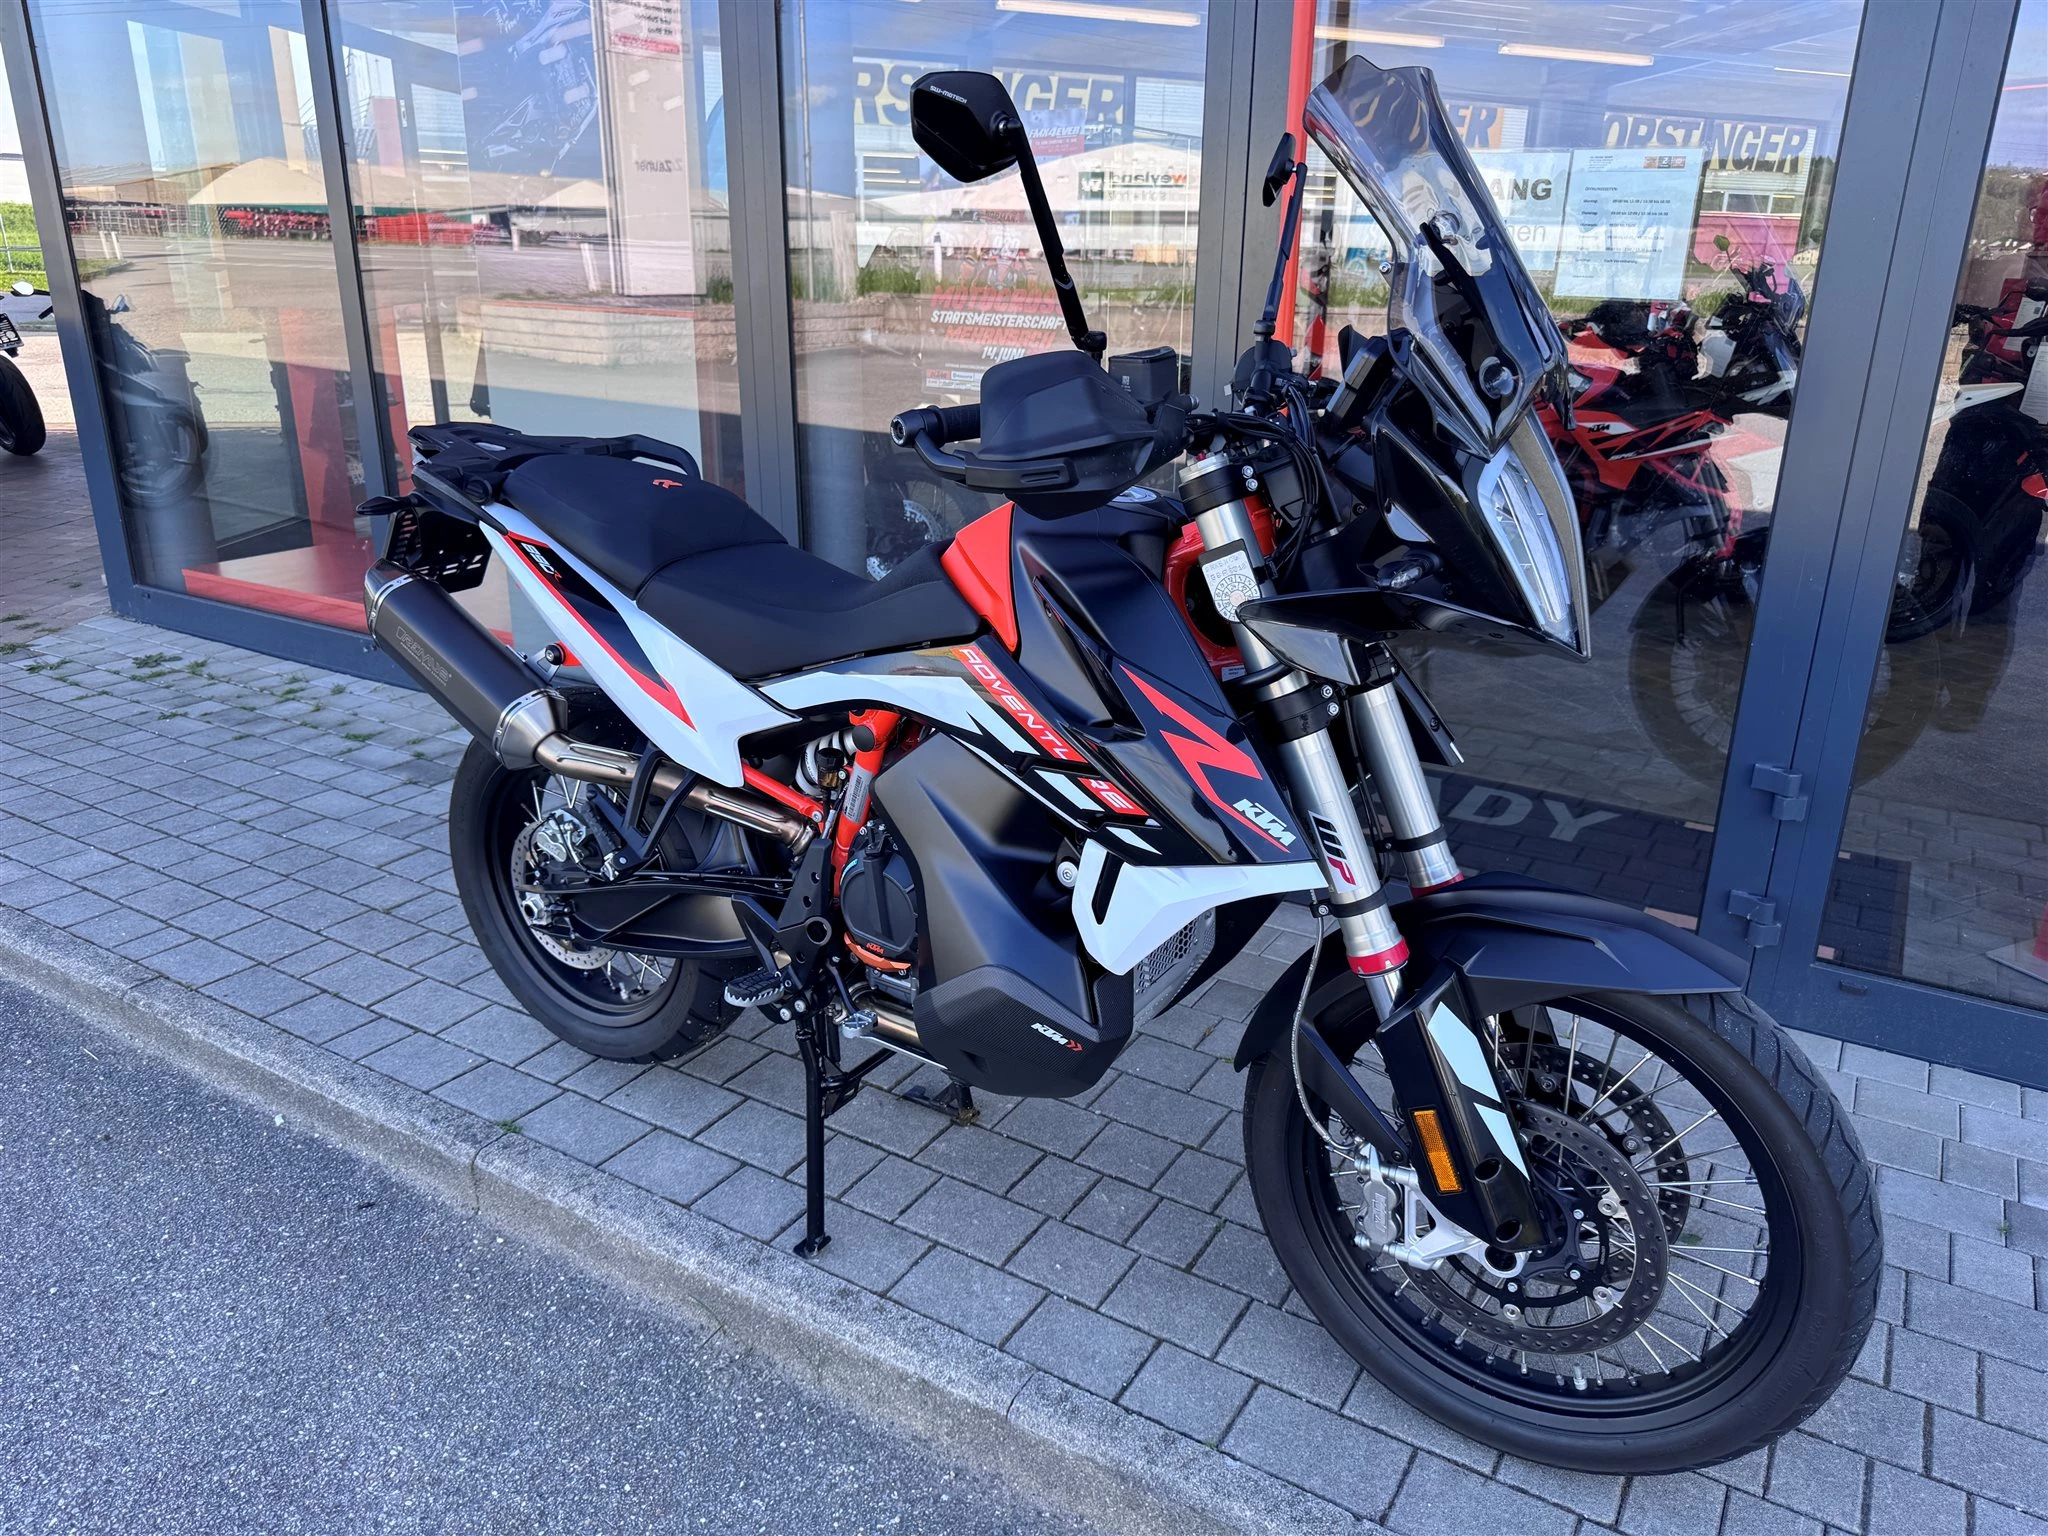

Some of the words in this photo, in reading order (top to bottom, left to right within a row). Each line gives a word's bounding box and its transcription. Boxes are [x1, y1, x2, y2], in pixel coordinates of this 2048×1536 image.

[1604, 114, 1808, 173] ORSTNGER
[930, 285, 1063, 315] MOTOCROS
[1232, 798, 1297, 847] KTM
[866, 942, 885, 954] KTM
[1030, 1022, 1069, 1045] KTM
